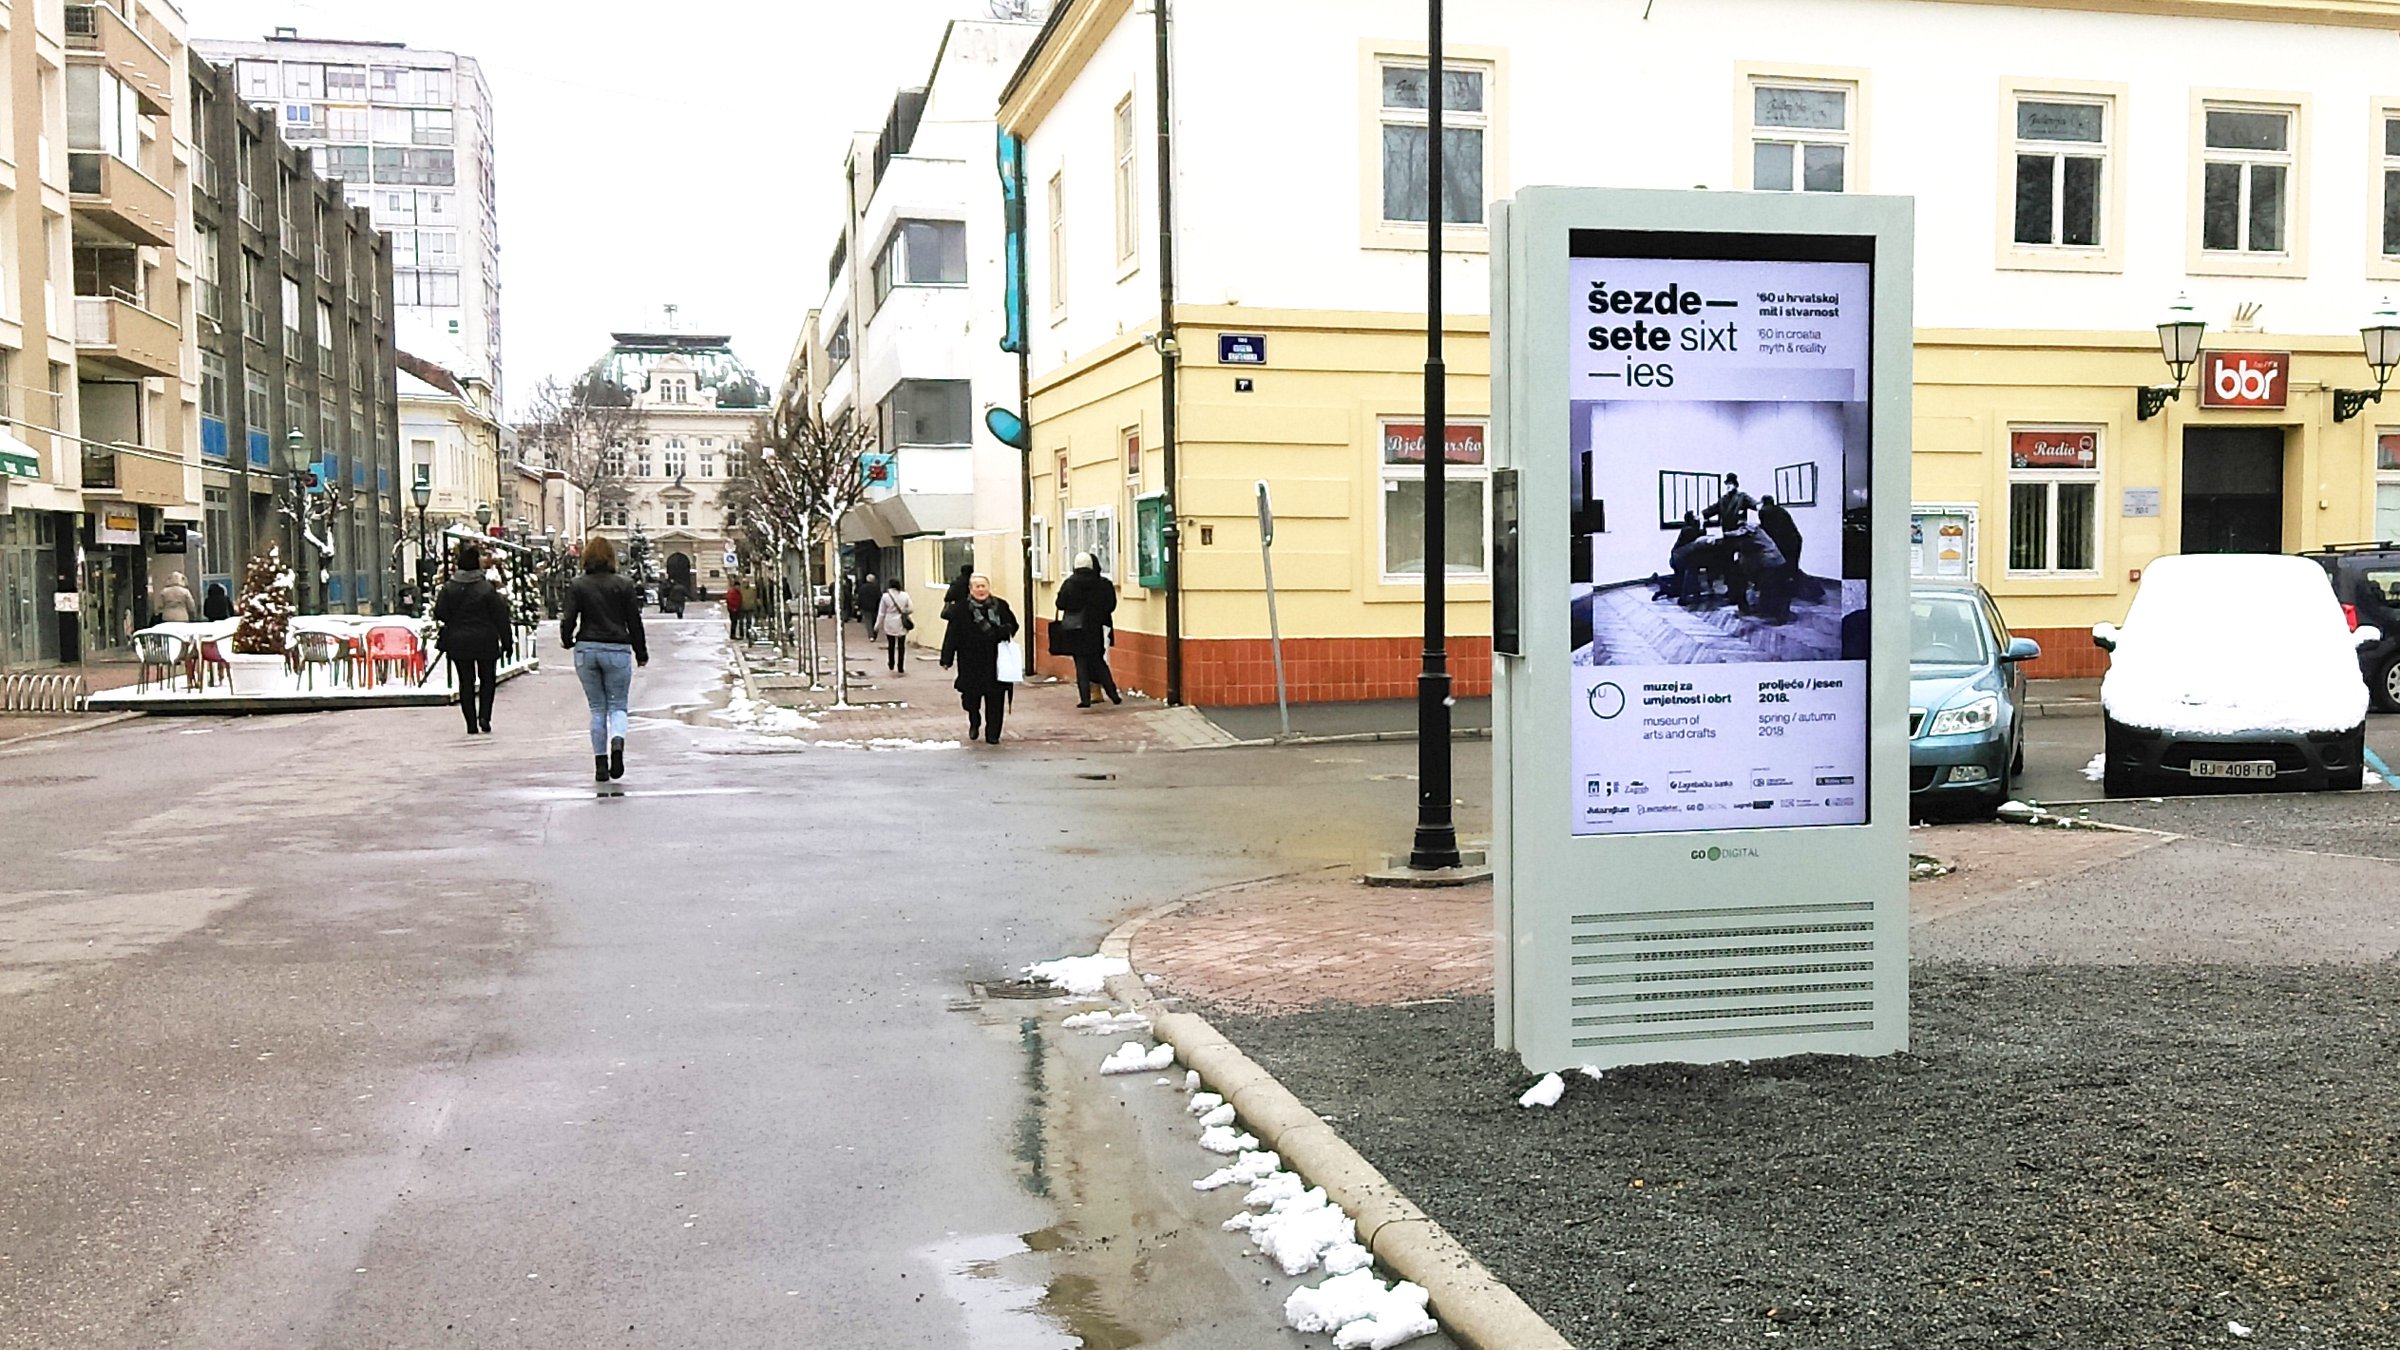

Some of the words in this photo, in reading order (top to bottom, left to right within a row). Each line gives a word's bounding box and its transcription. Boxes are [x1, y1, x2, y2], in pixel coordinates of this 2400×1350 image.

[1786, 292, 1839, 306] hrvatskoj
[1759, 306, 1778, 317] mit
[1785, 307, 1840, 318] stvarnost
[1588, 320, 1671, 351] sete
[1680, 319, 1738, 351] sixt
[1775, 328, 1785, 339] in
[1785, 330, 1822, 340] croatia
[1759, 342, 1785, 355] myth
[1786, 342, 1794, 353] &
[1795, 342, 1827, 355] reality
[2214, 359, 2278, 400] bbr
[2033, 441, 2075, 456] Radio
[1643, 681, 1678, 693] muzej
[1679, 682, 1693, 692] za
[1812, 678, 1843, 691] jesen
[1643, 694, 1701, 707] umjetnost
[1707, 693, 1732, 704] obrt
[1643, 716, 1688, 727] museum
[1689, 714, 1701, 726] of
[1758, 714, 1791, 725] spring
[1798, 712, 1837, 723] autumn
[1643, 729, 1664, 740] arts
[1665, 728, 1685, 740] and
[1686, 728, 1717, 739] crafts
[1758, 726, 1784, 737] 2018
[2200, 763, 2216, 776] BJ
[1690, 849, 1706, 860] GO
[1722, 847, 1759, 859] DIGITAL
